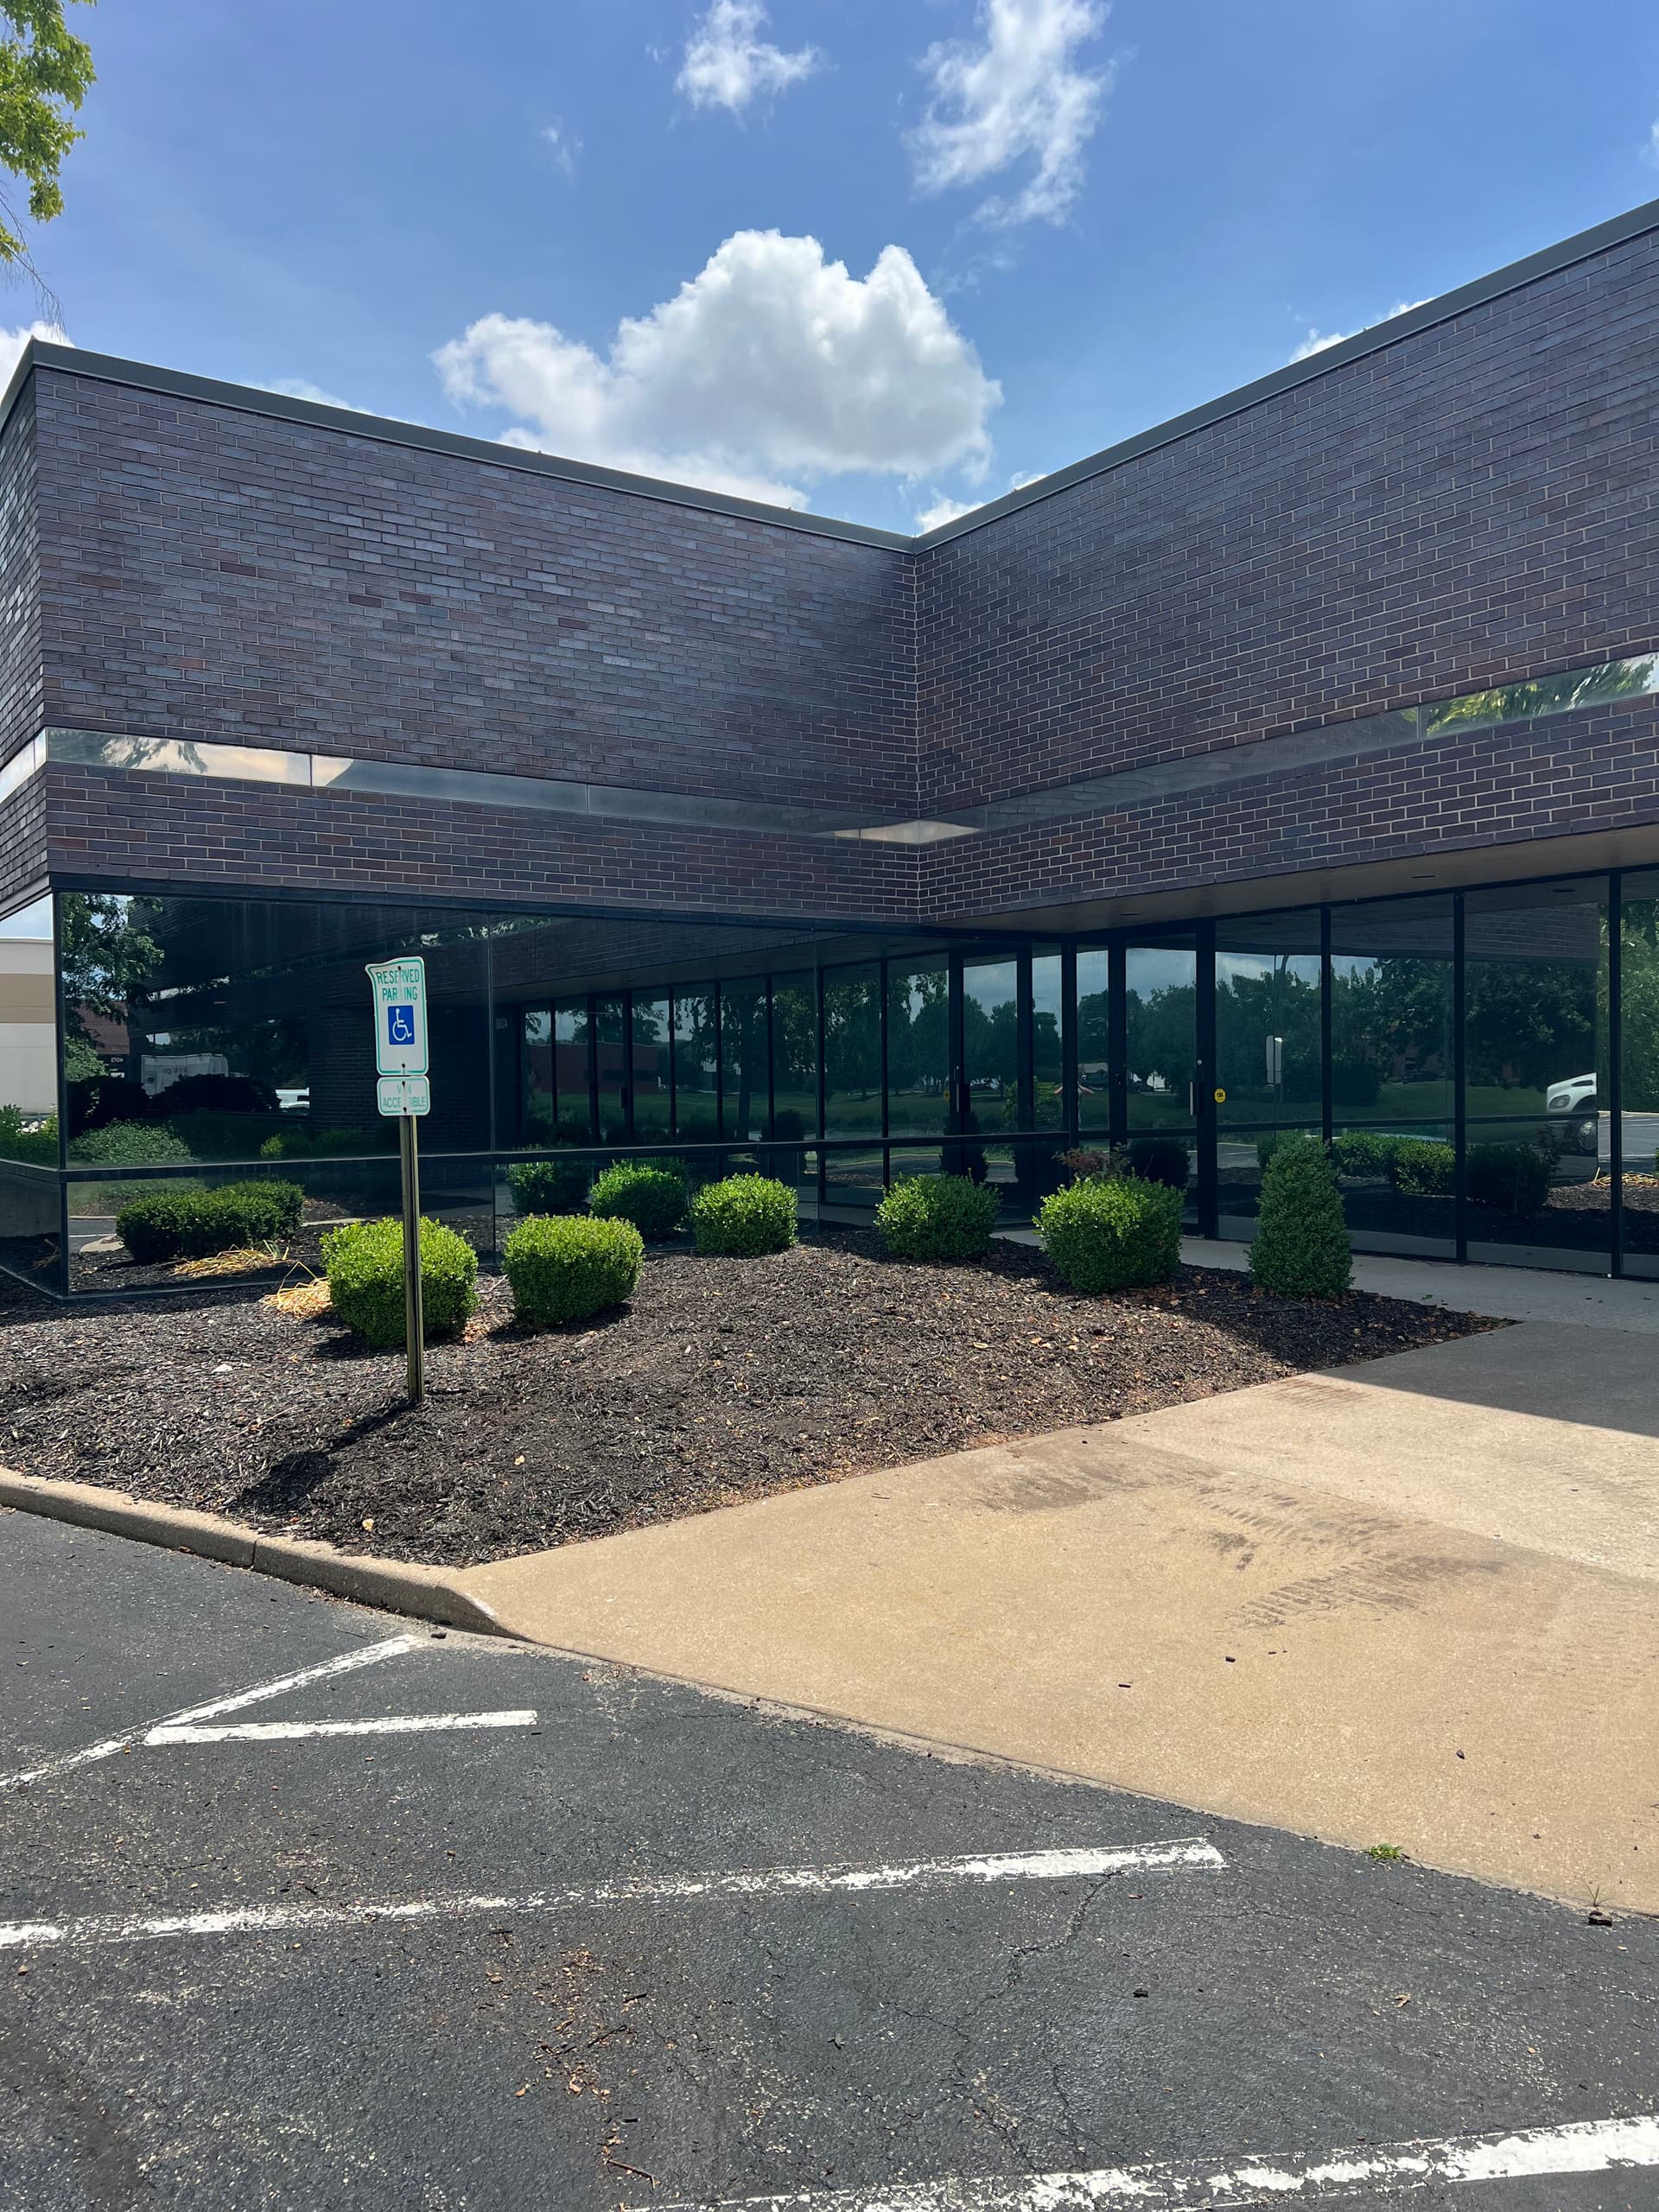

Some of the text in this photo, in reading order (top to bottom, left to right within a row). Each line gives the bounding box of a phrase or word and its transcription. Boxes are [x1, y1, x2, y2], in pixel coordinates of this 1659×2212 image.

[376, 969, 420, 985] RESERVED
[382, 986, 418, 1001] PARING
[396, 1084, 412, 1095] VN
